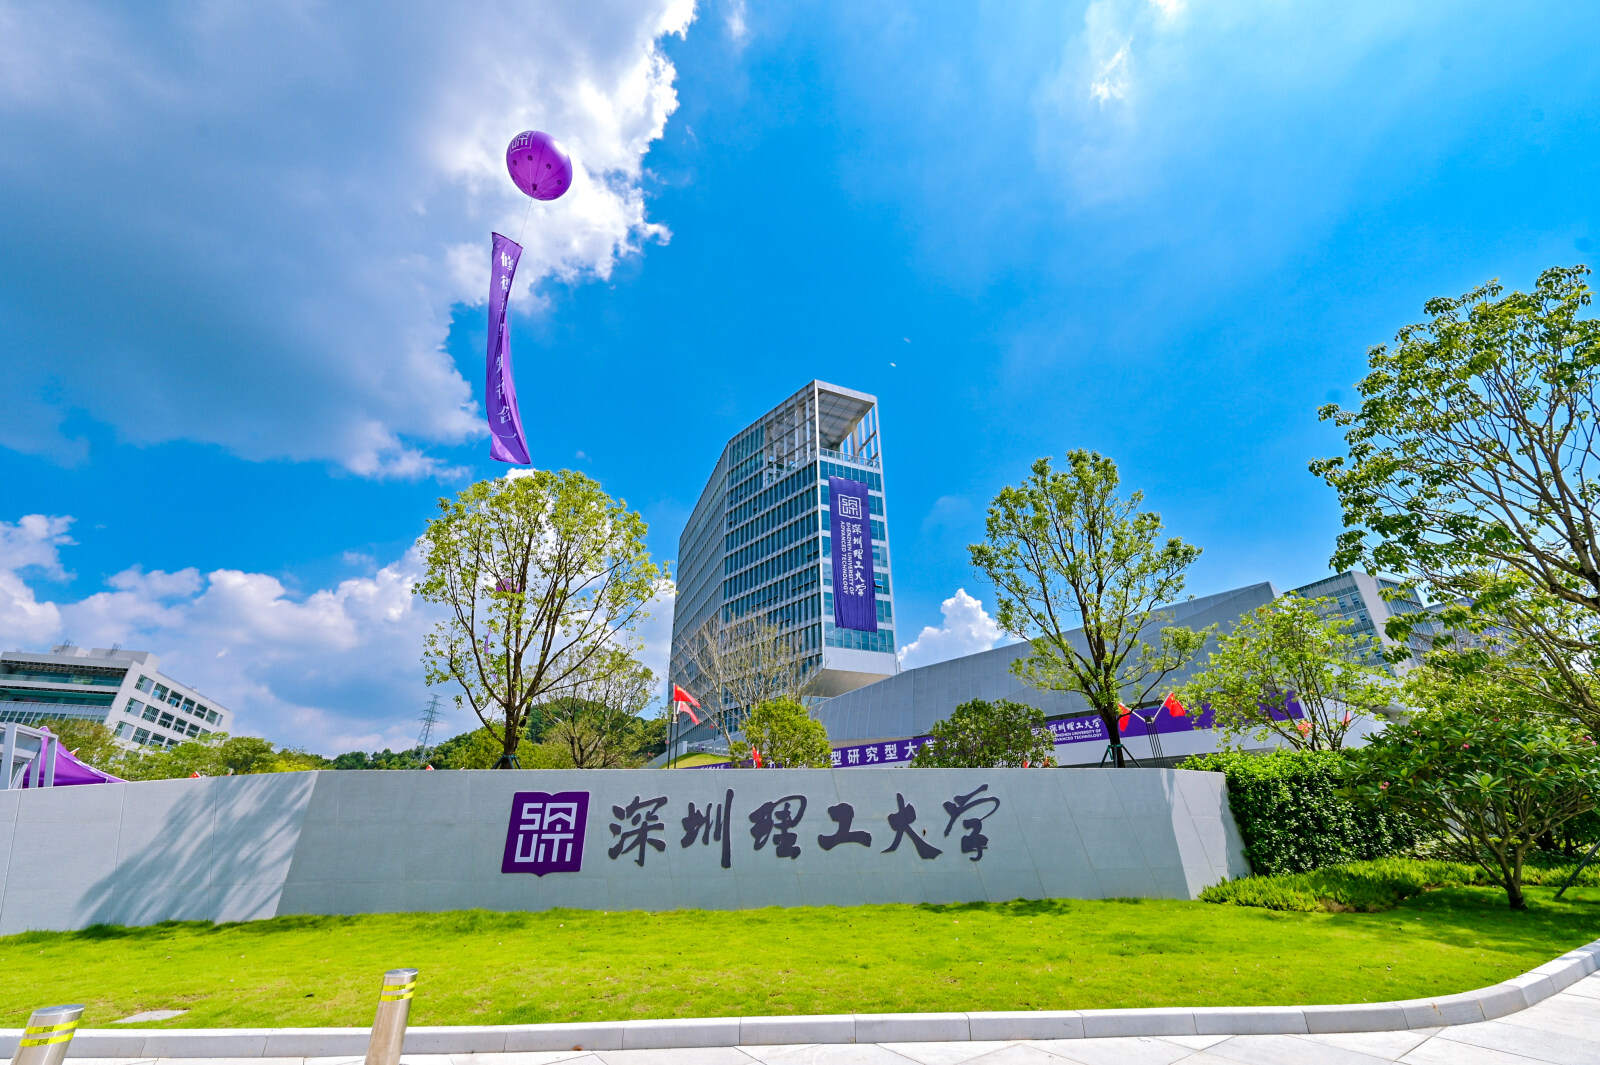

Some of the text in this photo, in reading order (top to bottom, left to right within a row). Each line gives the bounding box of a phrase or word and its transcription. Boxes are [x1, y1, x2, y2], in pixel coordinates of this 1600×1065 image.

[841, 553, 849, 595] TECHNOLOGY
[852, 523, 866, 597] 深圳理工大学
[607, 784, 1001, 868] 深圳理工大学
